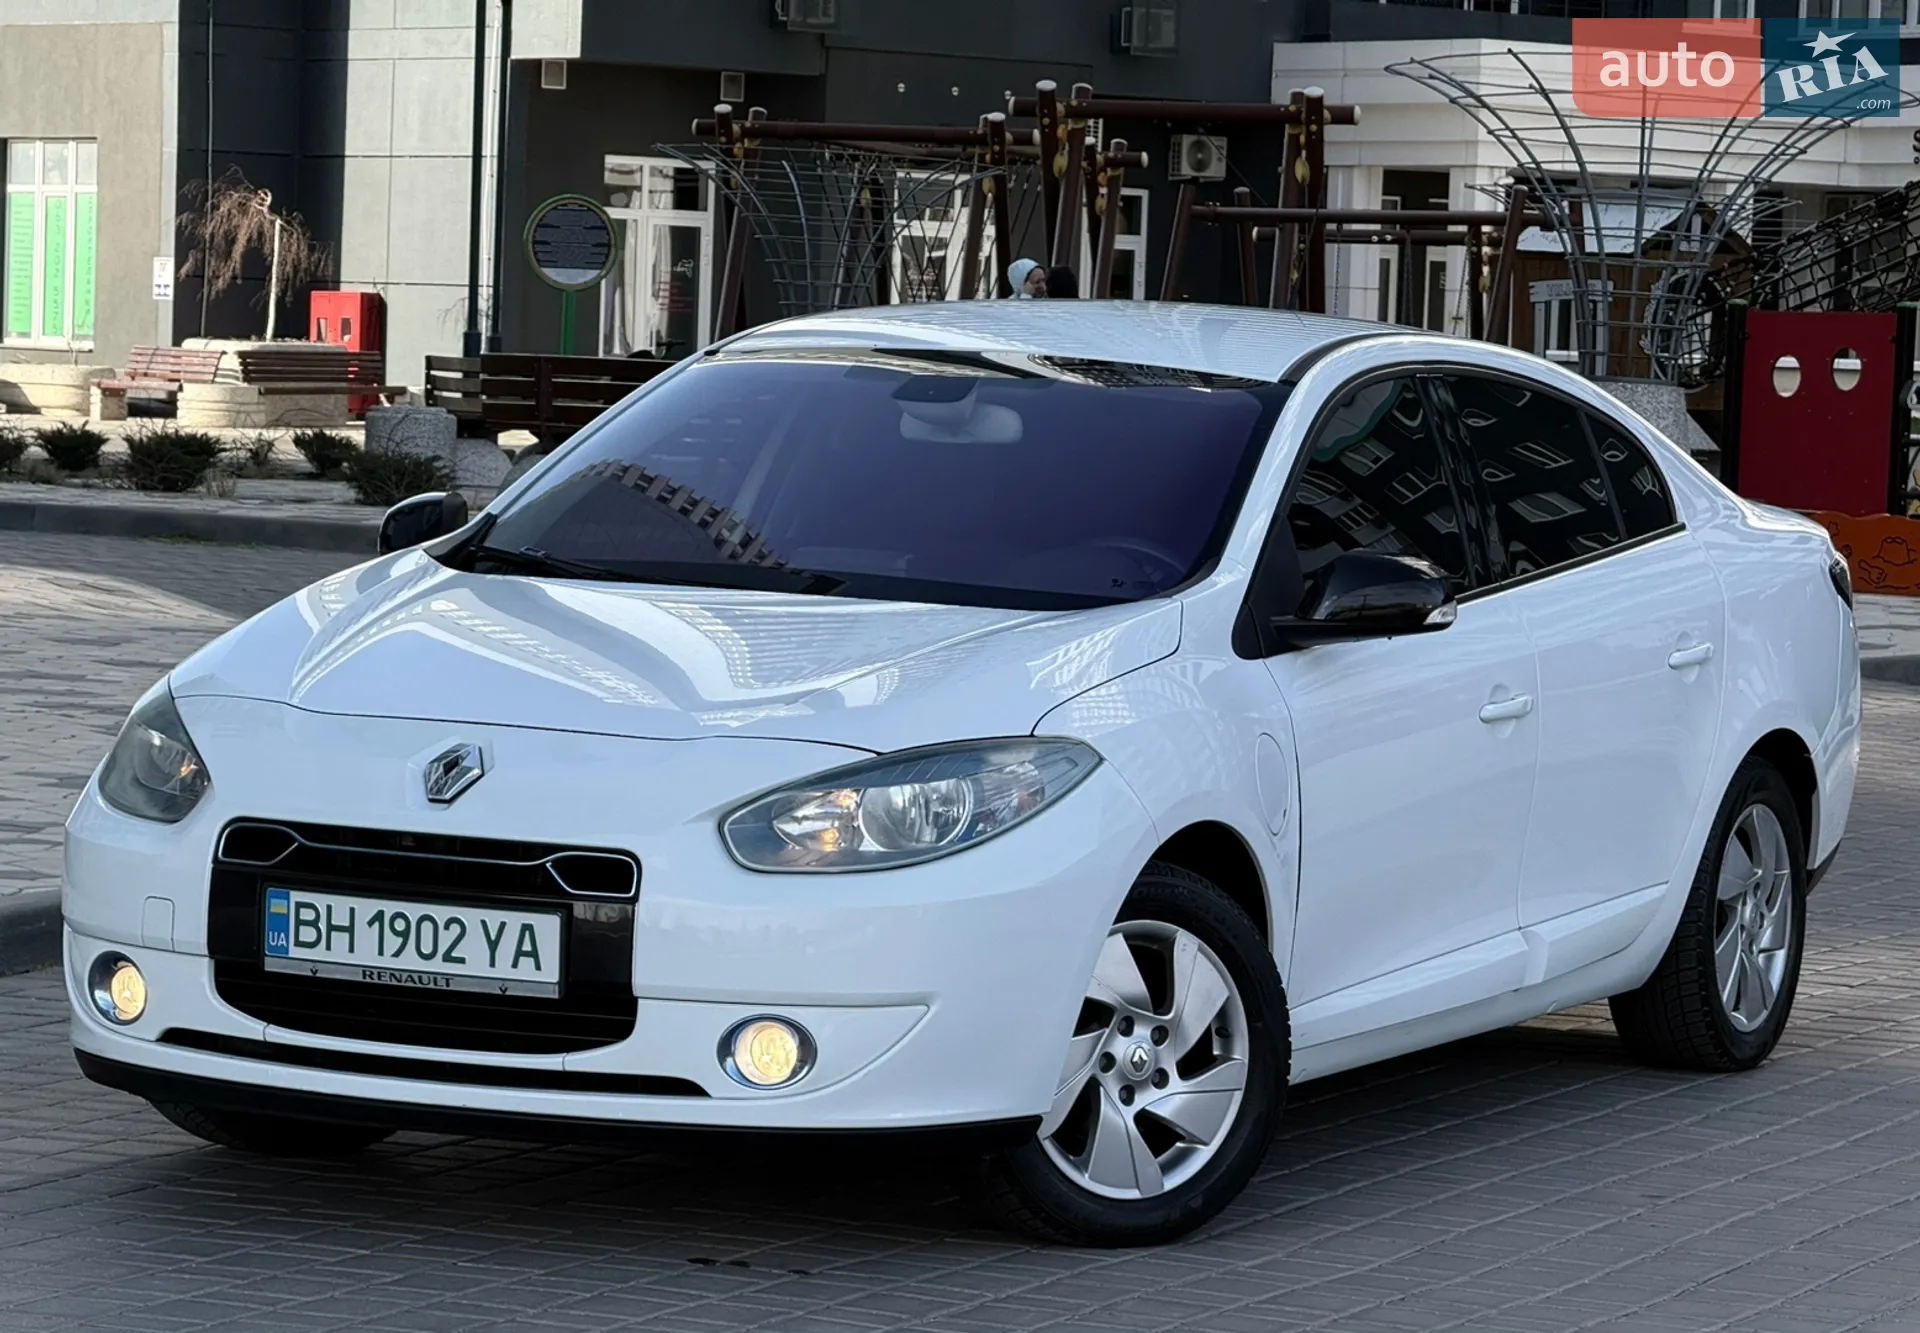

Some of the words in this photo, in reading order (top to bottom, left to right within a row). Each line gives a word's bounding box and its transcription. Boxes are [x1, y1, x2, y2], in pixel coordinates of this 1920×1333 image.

[269, 931, 287, 947] UA
[293, 900, 356, 954] BH
[366, 908, 467, 965] 1902
[480, 918, 542, 971] YA
[362, 969, 455, 989] RENAULT
